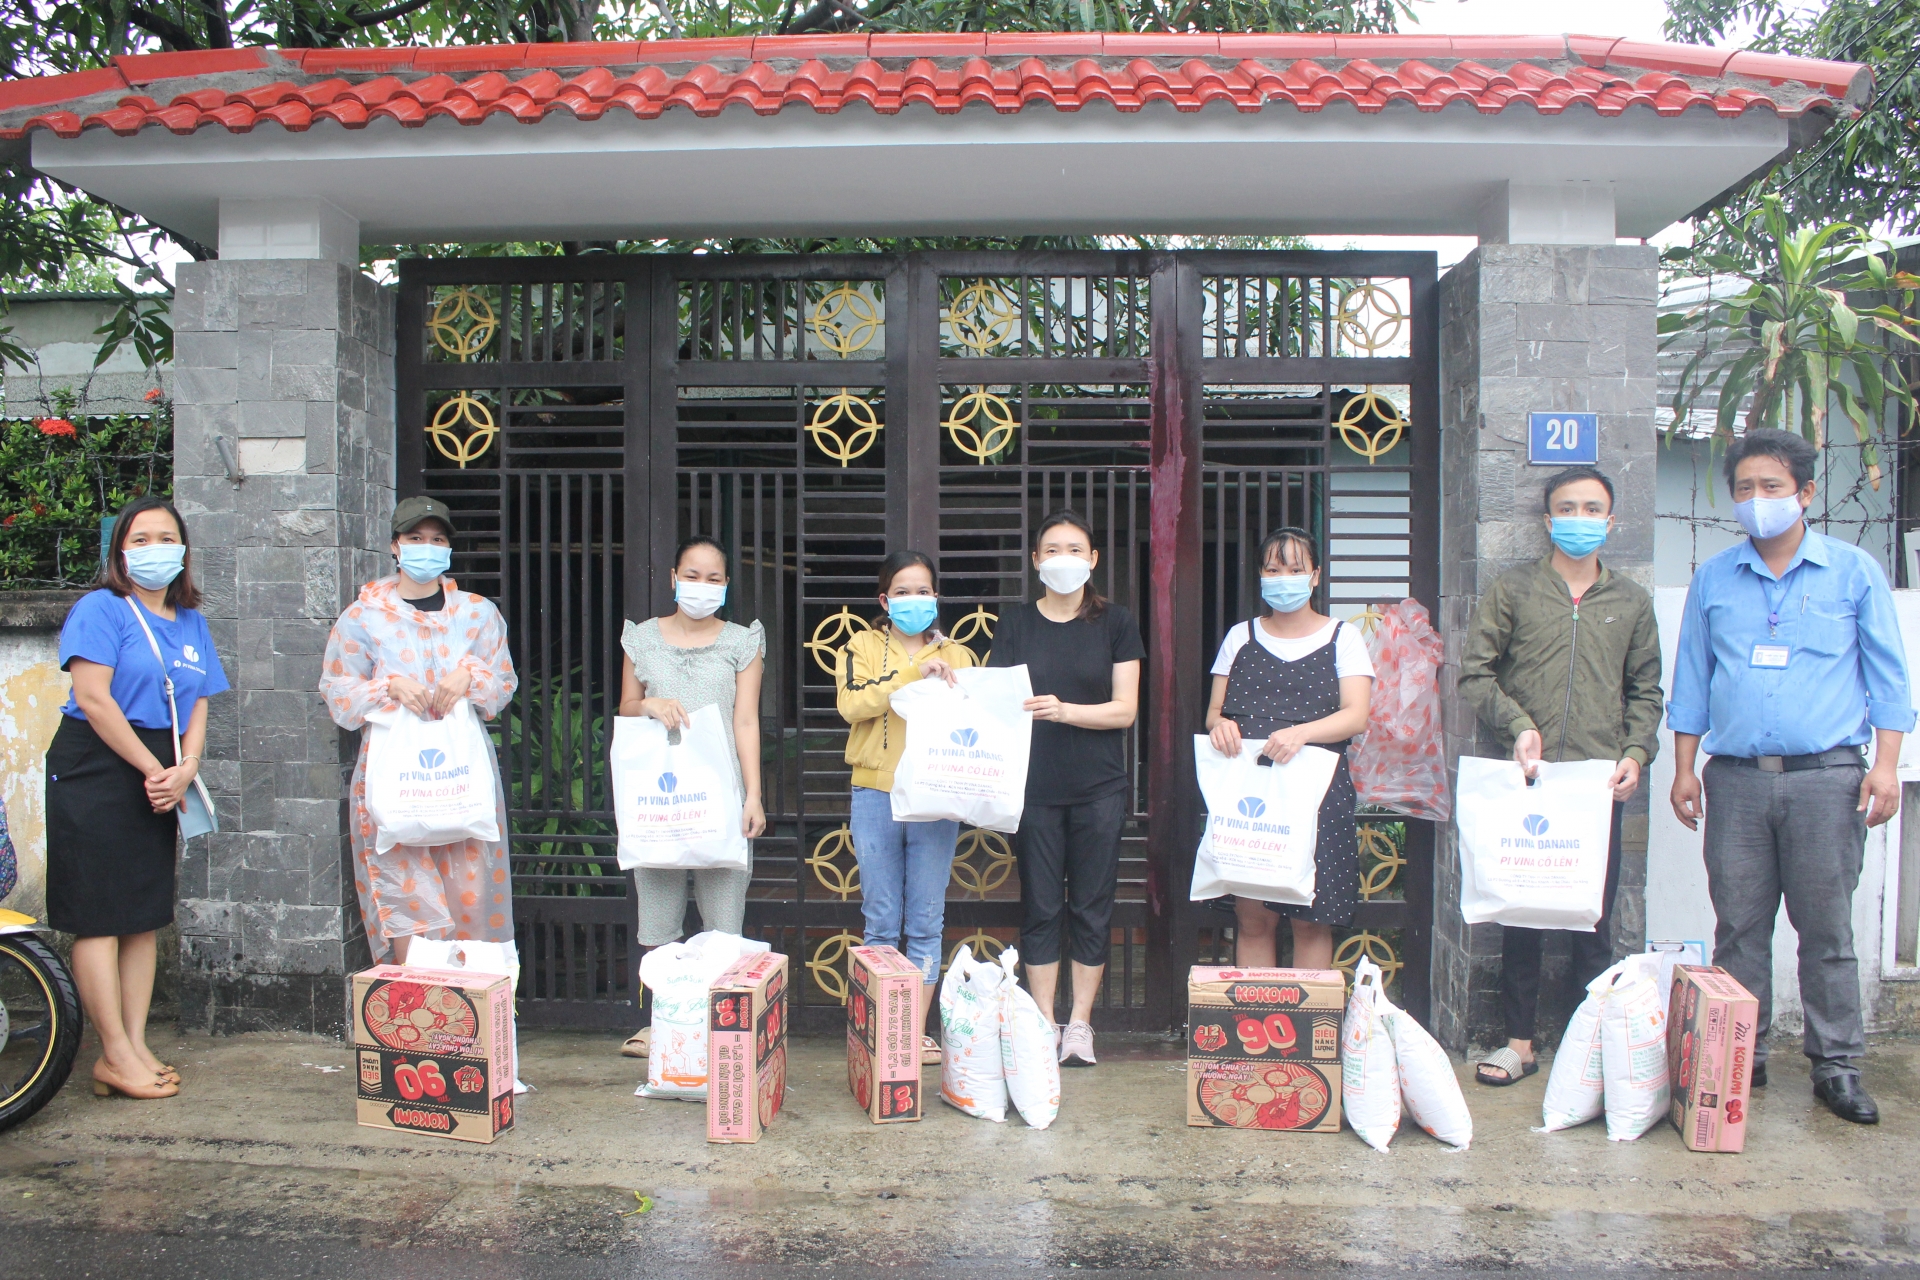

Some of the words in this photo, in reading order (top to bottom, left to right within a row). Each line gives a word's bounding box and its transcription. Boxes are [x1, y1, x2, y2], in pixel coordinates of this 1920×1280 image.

[1546, 419, 1578, 450] 20
[929, 748, 938, 756] PI
[942, 748, 965, 757] VINA
[968, 750, 1004, 762] DANANG
[400, 772, 409, 782] PI
[412, 771, 432, 782] VINA
[435, 765, 469, 780] DANANG
[942, 764, 964, 773] VINA
[400, 789, 410, 798] PI
[412, 789, 433, 798] VINA
[638, 796, 647, 806] PI
[650, 796, 670, 806] VINA
[673, 792, 707, 806] DANANG
[637, 814, 647, 822] PI
[649, 814, 669, 823] VINA
[1214, 815, 1224, 826] PI
[1227, 817, 1249, 831] VINA
[1252, 822, 1291, 836] DANANG
[1212, 833, 1222, 843] PI
[1223, 836, 1246, 847] VINA
[1501, 838, 1511, 848] PI
[1515, 838, 1535, 849] VINA
[1538, 839, 1580, 850] DANANG
[1500, 857, 1511, 866] PI
[1514, 857, 1535, 867] VINA
[888, 989, 898, 1015] GAM
[1235, 986, 1300, 1004] KOKOMI
[716, 998, 737, 1027] 90
[739, 996, 749, 1029] KOKOMI
[900, 1004, 911, 1032] KHÔNG
[889, 1017, 898, 1030] 75
[1314, 1028, 1335, 1037] SIÊU
[887, 1032, 898, 1052] GÓI
[900, 1033, 911, 1050] BÁN
[1237, 1013, 1297, 1056] 90
[719, 1045, 731, 1060] GIÁ
[900, 1053, 911, 1067] GIÁ
[1679, 1031, 1694, 1089] 90
[363, 1071, 380, 1081] SIÊU
[394, 1059, 447, 1101] 90
[719, 1063, 731, 1081] BÁN
[733, 1062, 745, 1082] GÓI
[1731, 1046, 1747, 1095] KOKOMI
[719, 1082, 730, 1111] KHÔNG
[733, 1084, 743, 1098] 75
[883, 1085, 891, 1116] KOKOMI
[894, 1085, 914, 1113] 90
[394, 1107, 450, 1130] KOKOMI
[733, 1099, 743, 1126] GAM
[1725, 1099, 1744, 1125] 90
